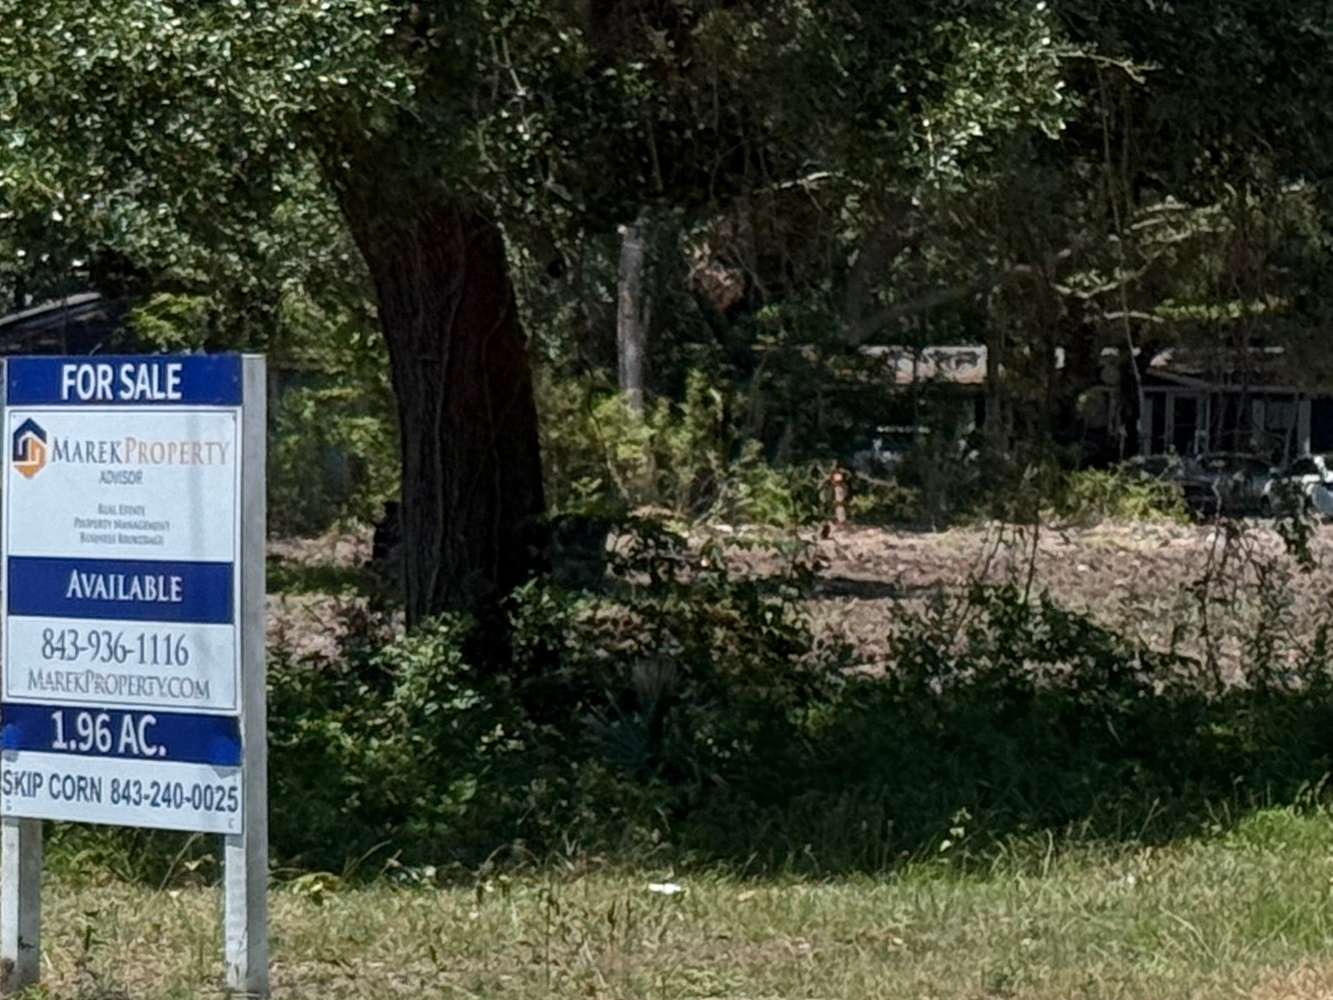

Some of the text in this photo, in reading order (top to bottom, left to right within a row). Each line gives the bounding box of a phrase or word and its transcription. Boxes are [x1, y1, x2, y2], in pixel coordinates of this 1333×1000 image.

[62, 363, 183, 401] FOR SALE
[98, 469, 143, 486] ADVISOR
[41, 627, 190, 667] 843-936-1116
[51, 709, 167, 757] 1.96 AC.
[2, 769, 238, 812] SKIP CORN 843-240-0025
